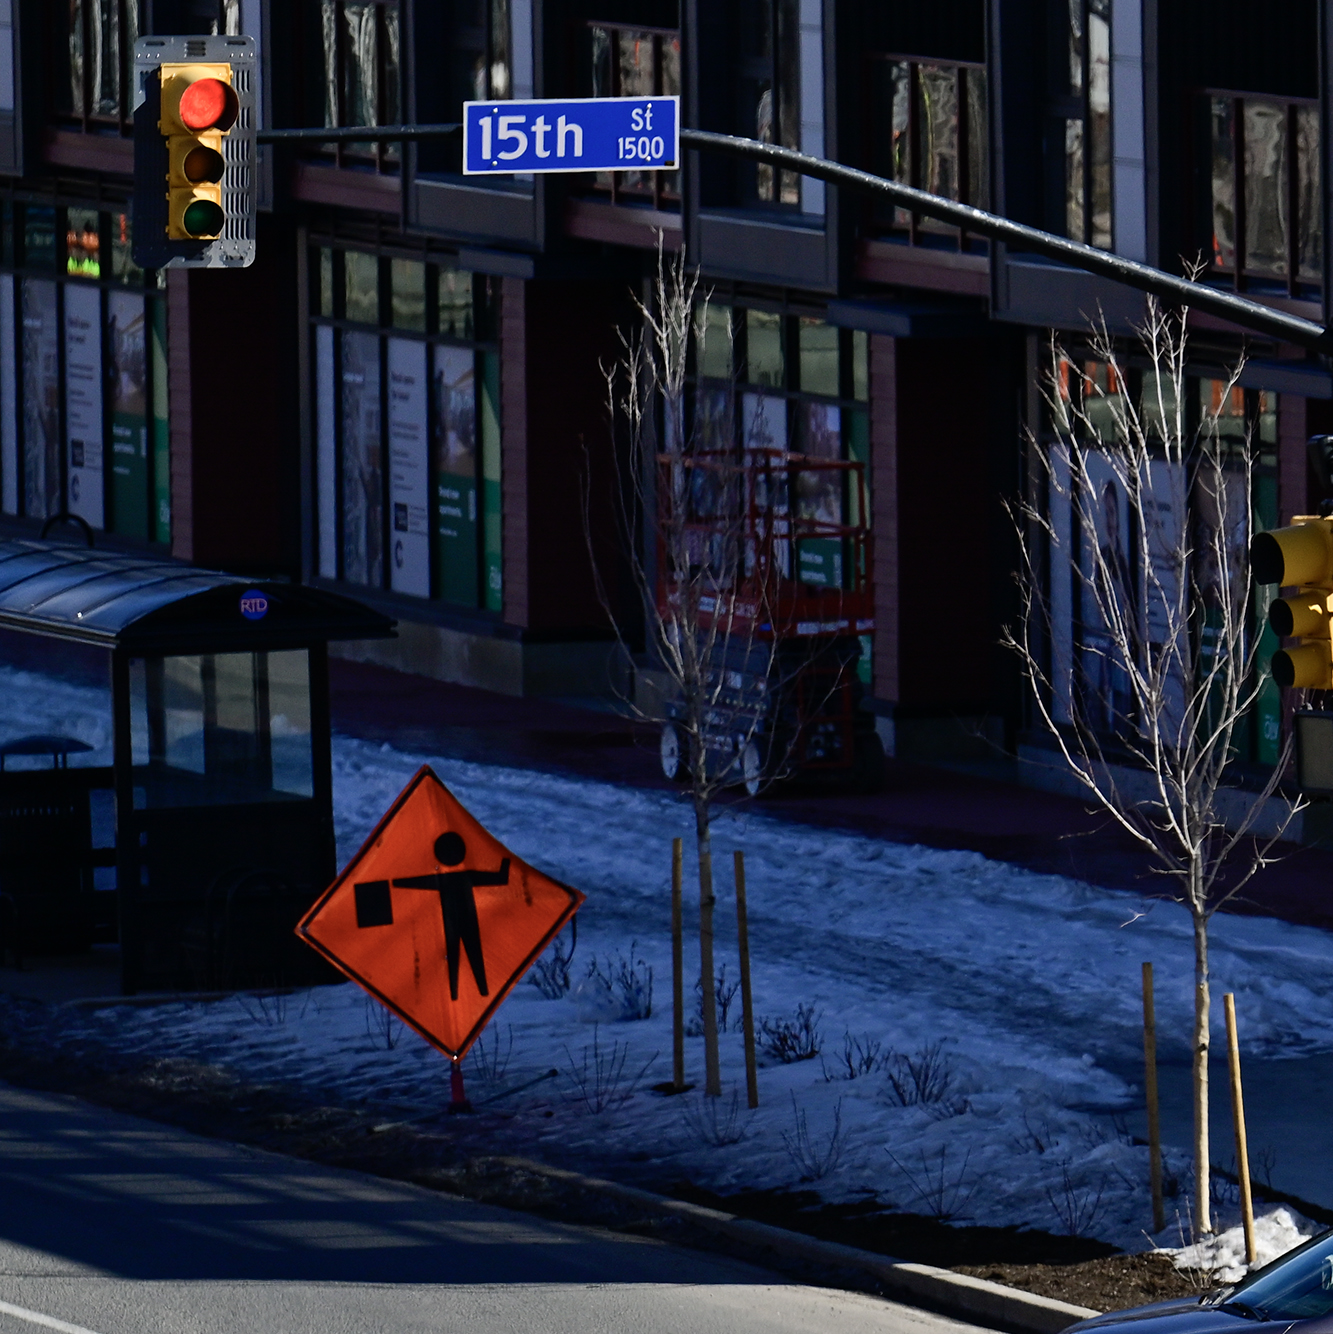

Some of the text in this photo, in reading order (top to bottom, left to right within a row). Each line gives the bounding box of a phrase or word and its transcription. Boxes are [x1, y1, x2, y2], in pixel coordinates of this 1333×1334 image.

[478, 107, 653, 160] 15th St
[618, 136, 665, 160] 1500
[240, 598, 268, 613] RTD
